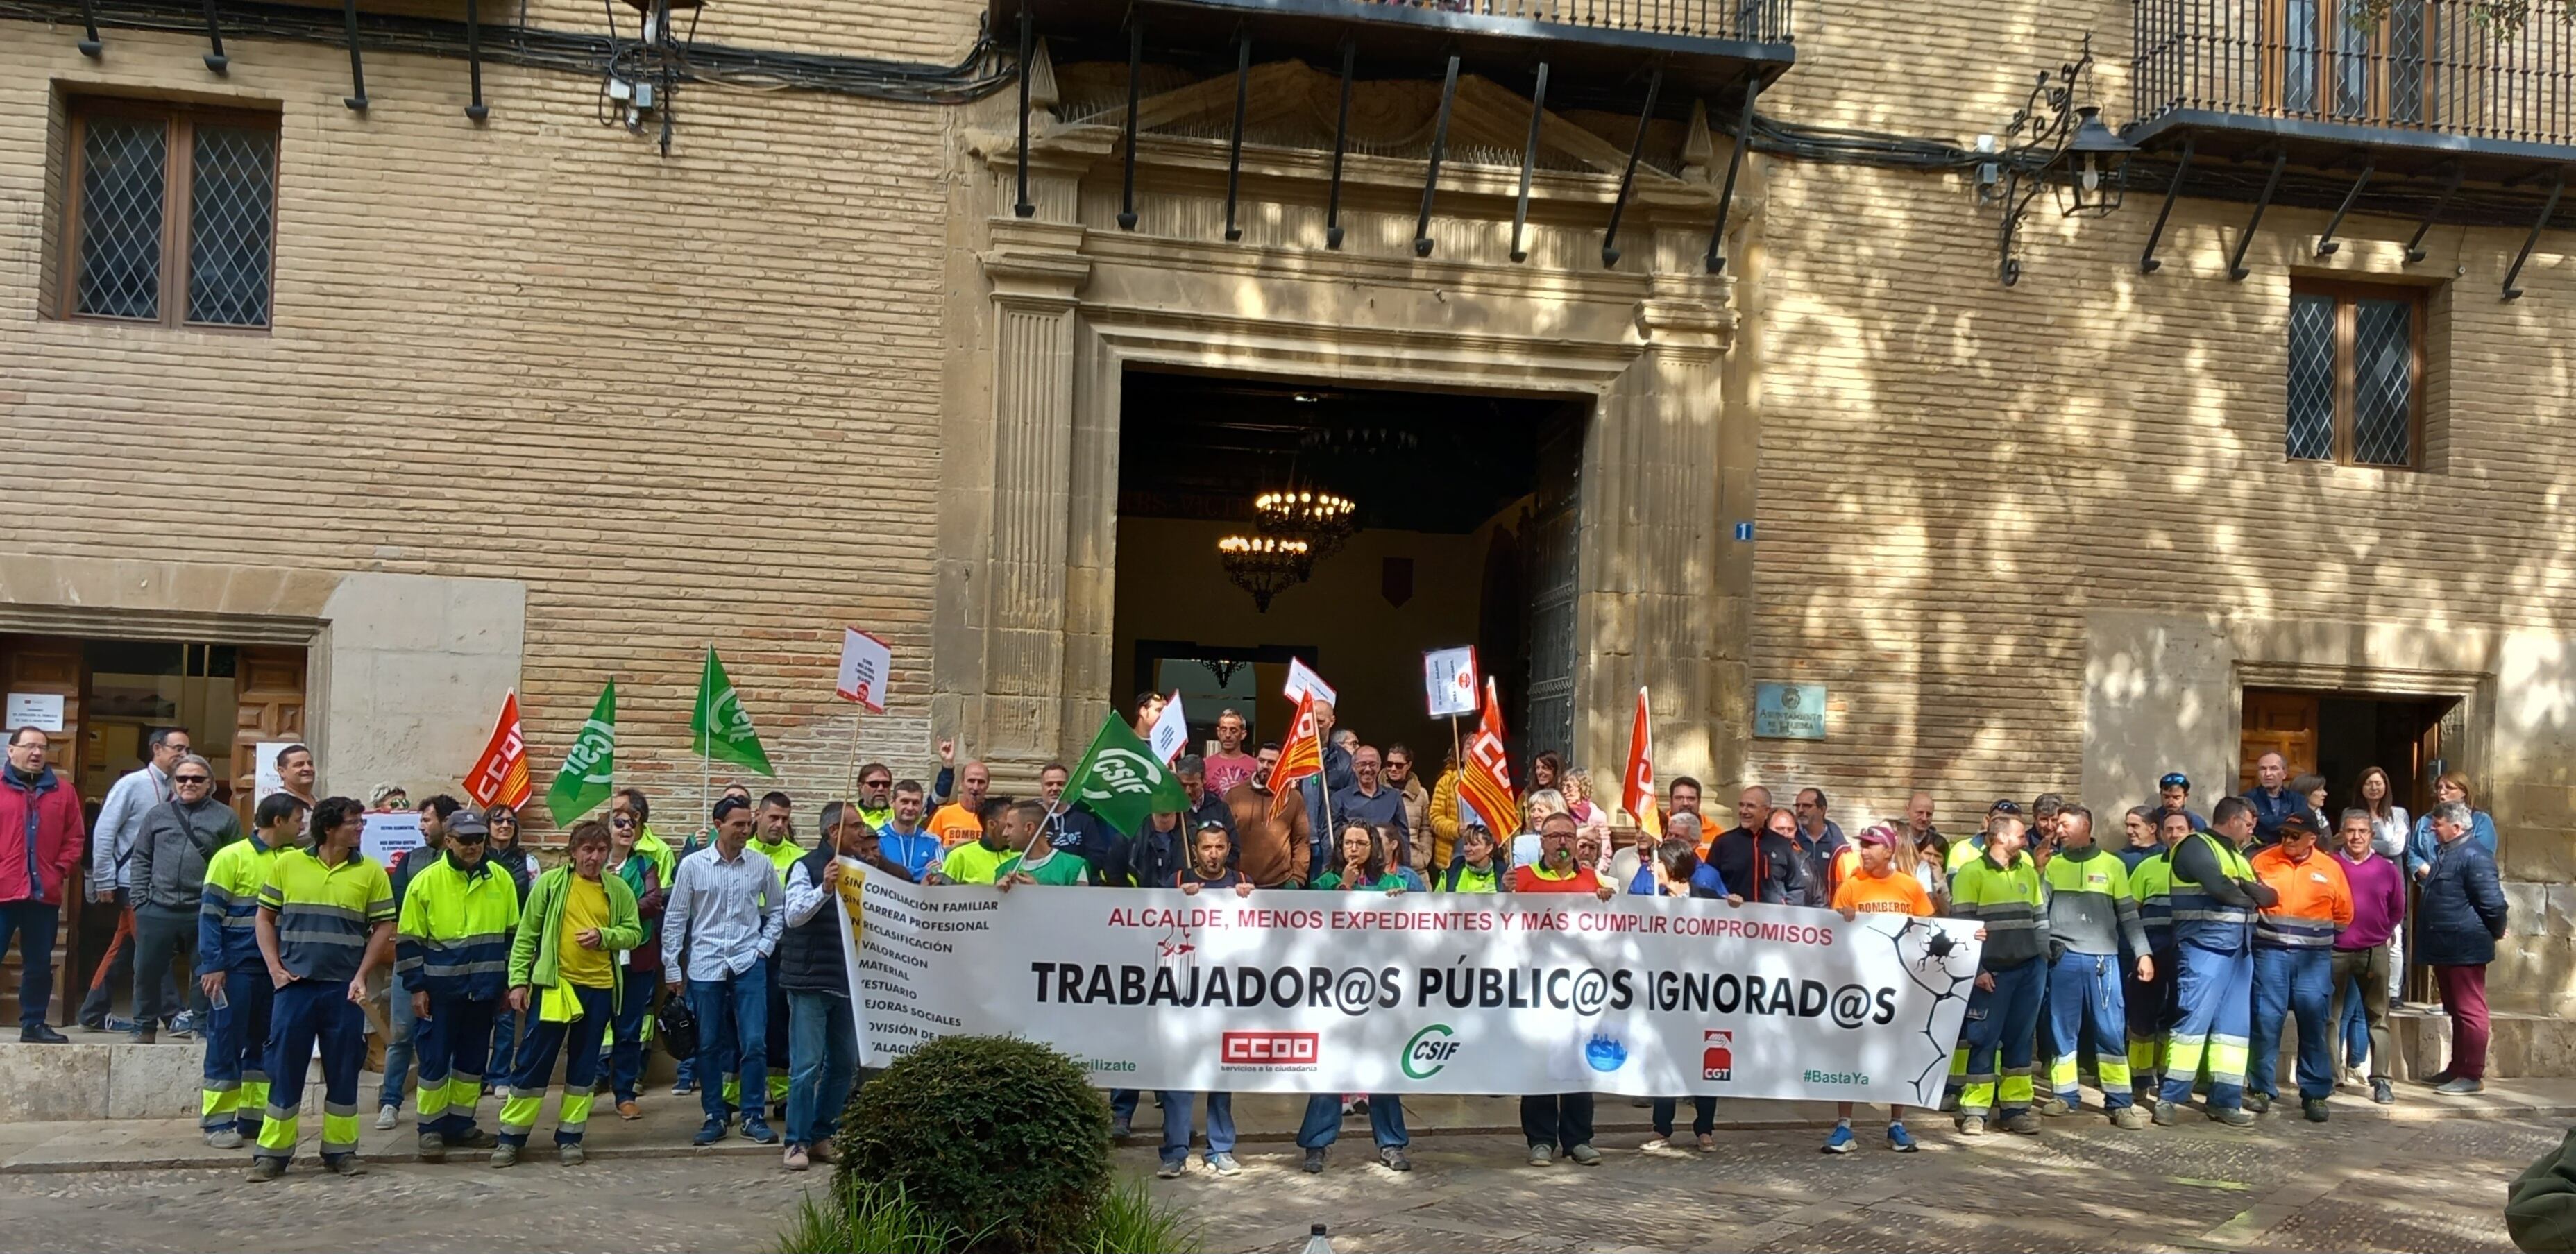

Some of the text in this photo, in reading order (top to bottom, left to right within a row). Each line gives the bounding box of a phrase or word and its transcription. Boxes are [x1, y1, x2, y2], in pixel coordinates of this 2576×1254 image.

[1740, 523, 1747, 540] 1
[1092, 759, 1152, 794] CSIF
[844, 876, 998, 912] SIN CONCILIACIÓN FAMILIAR
[843, 894, 989, 931] SIN CARRERA PROFESIONAL
[1858, 902, 1910, 914] BOMBEROS
[863, 921, 953, 953] RECLASIFICACIÓN
[1108, 908, 1833, 946] ALCALDE, MENOS EXPEDIENTES Y MÁS CUMPLIR COMPROMISOS
[862, 940, 928, 969] VALORACIÓN
[858, 959, 910, 981] MATERIAL
[1032, 955, 1897, 1029] TRABAJADOR@S PÚBLIC@S IGNORAD@S
[911, 1008, 962, 1027] SOCIALES
[1228, 1038, 1313, 1058] CCOO
[1414, 1041, 1460, 1060] CSIF
[1704, 1068, 1729, 1078] CGT
[1804, 1069, 1869, 1085] #BastaYa
